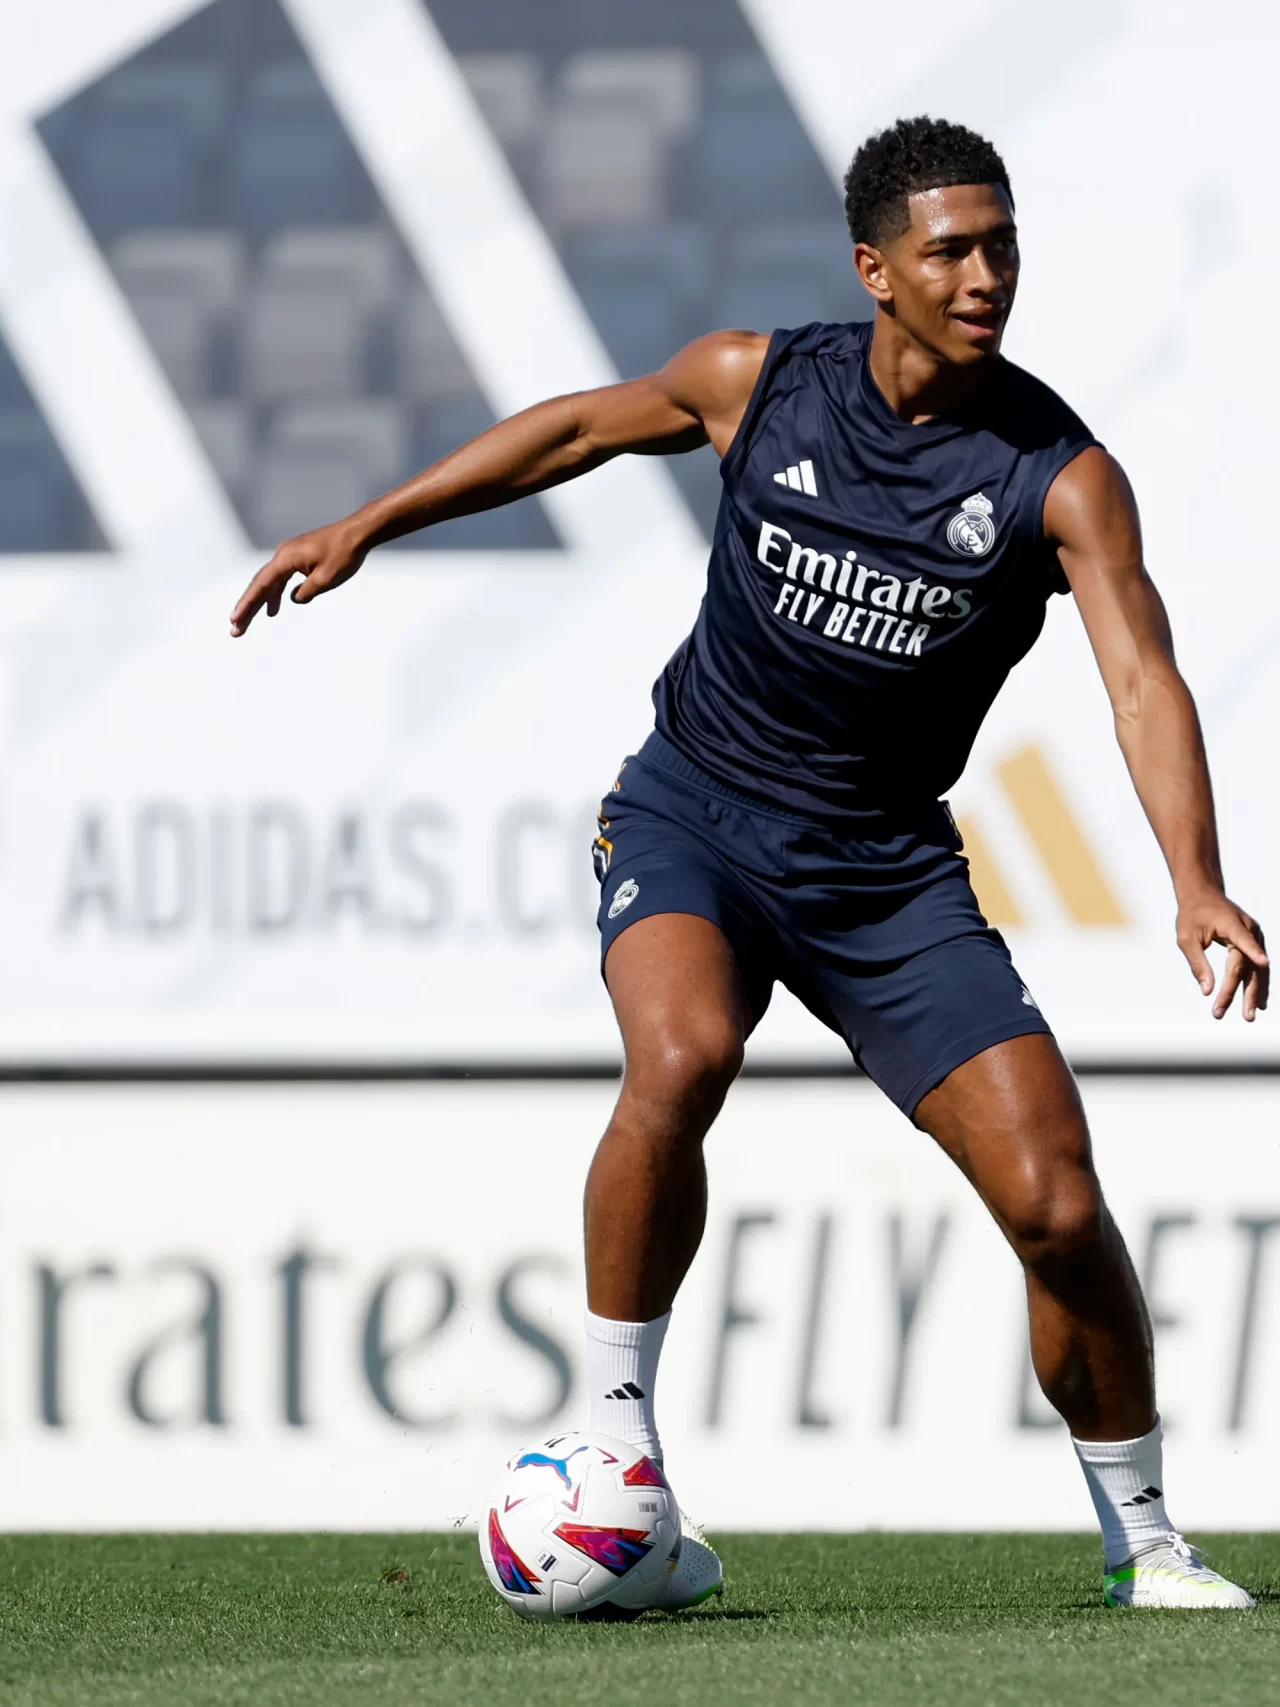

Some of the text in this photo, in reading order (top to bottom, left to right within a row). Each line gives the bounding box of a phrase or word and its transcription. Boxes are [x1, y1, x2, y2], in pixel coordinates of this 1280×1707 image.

[757, 521, 973, 619] Emirates
[773, 582, 931, 657] FLY BETTER
[33, 1224, 576, 1431] rates
[704, 1210, 950, 1434] FLY
